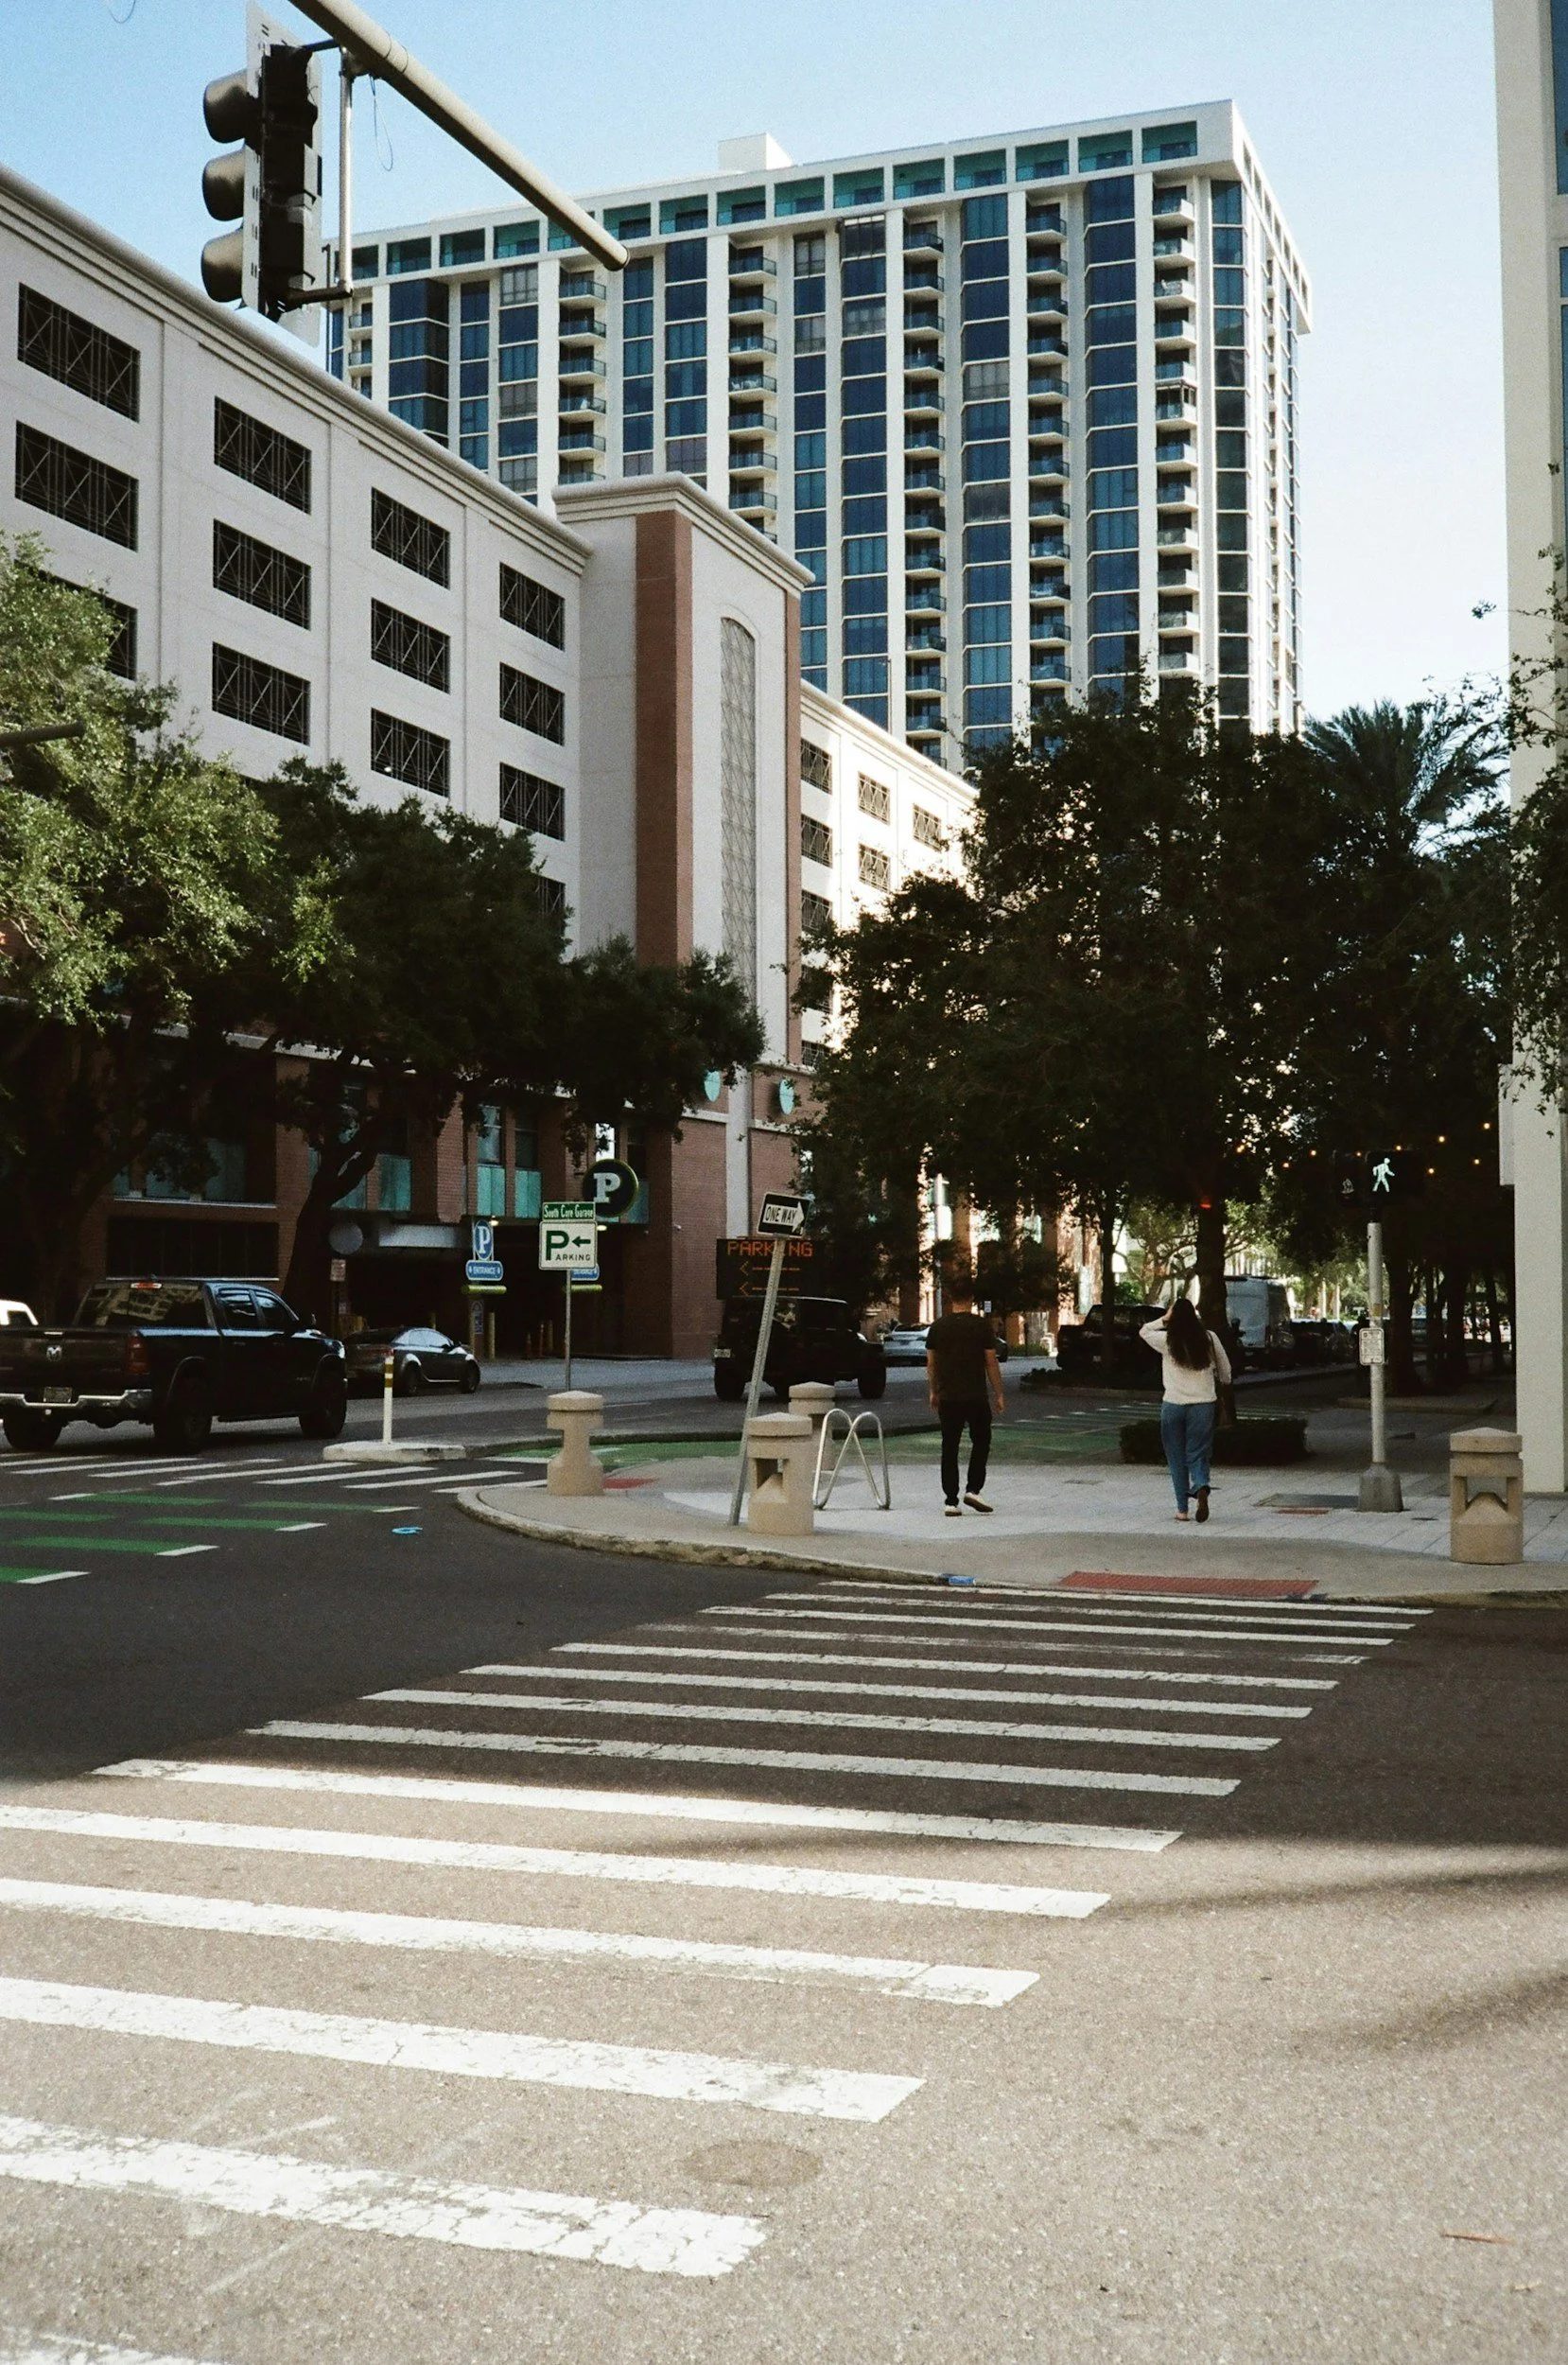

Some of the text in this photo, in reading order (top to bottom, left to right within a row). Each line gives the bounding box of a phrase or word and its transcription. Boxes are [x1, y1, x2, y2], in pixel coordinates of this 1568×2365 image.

[593, 1172, 621, 1202] P
[544, 1204, 594, 1218] South Core Garage
[765, 1206, 797, 1224] ONE WAY
[478, 1226, 491, 1253] P
[727, 1241, 814, 1257] PARKNG
